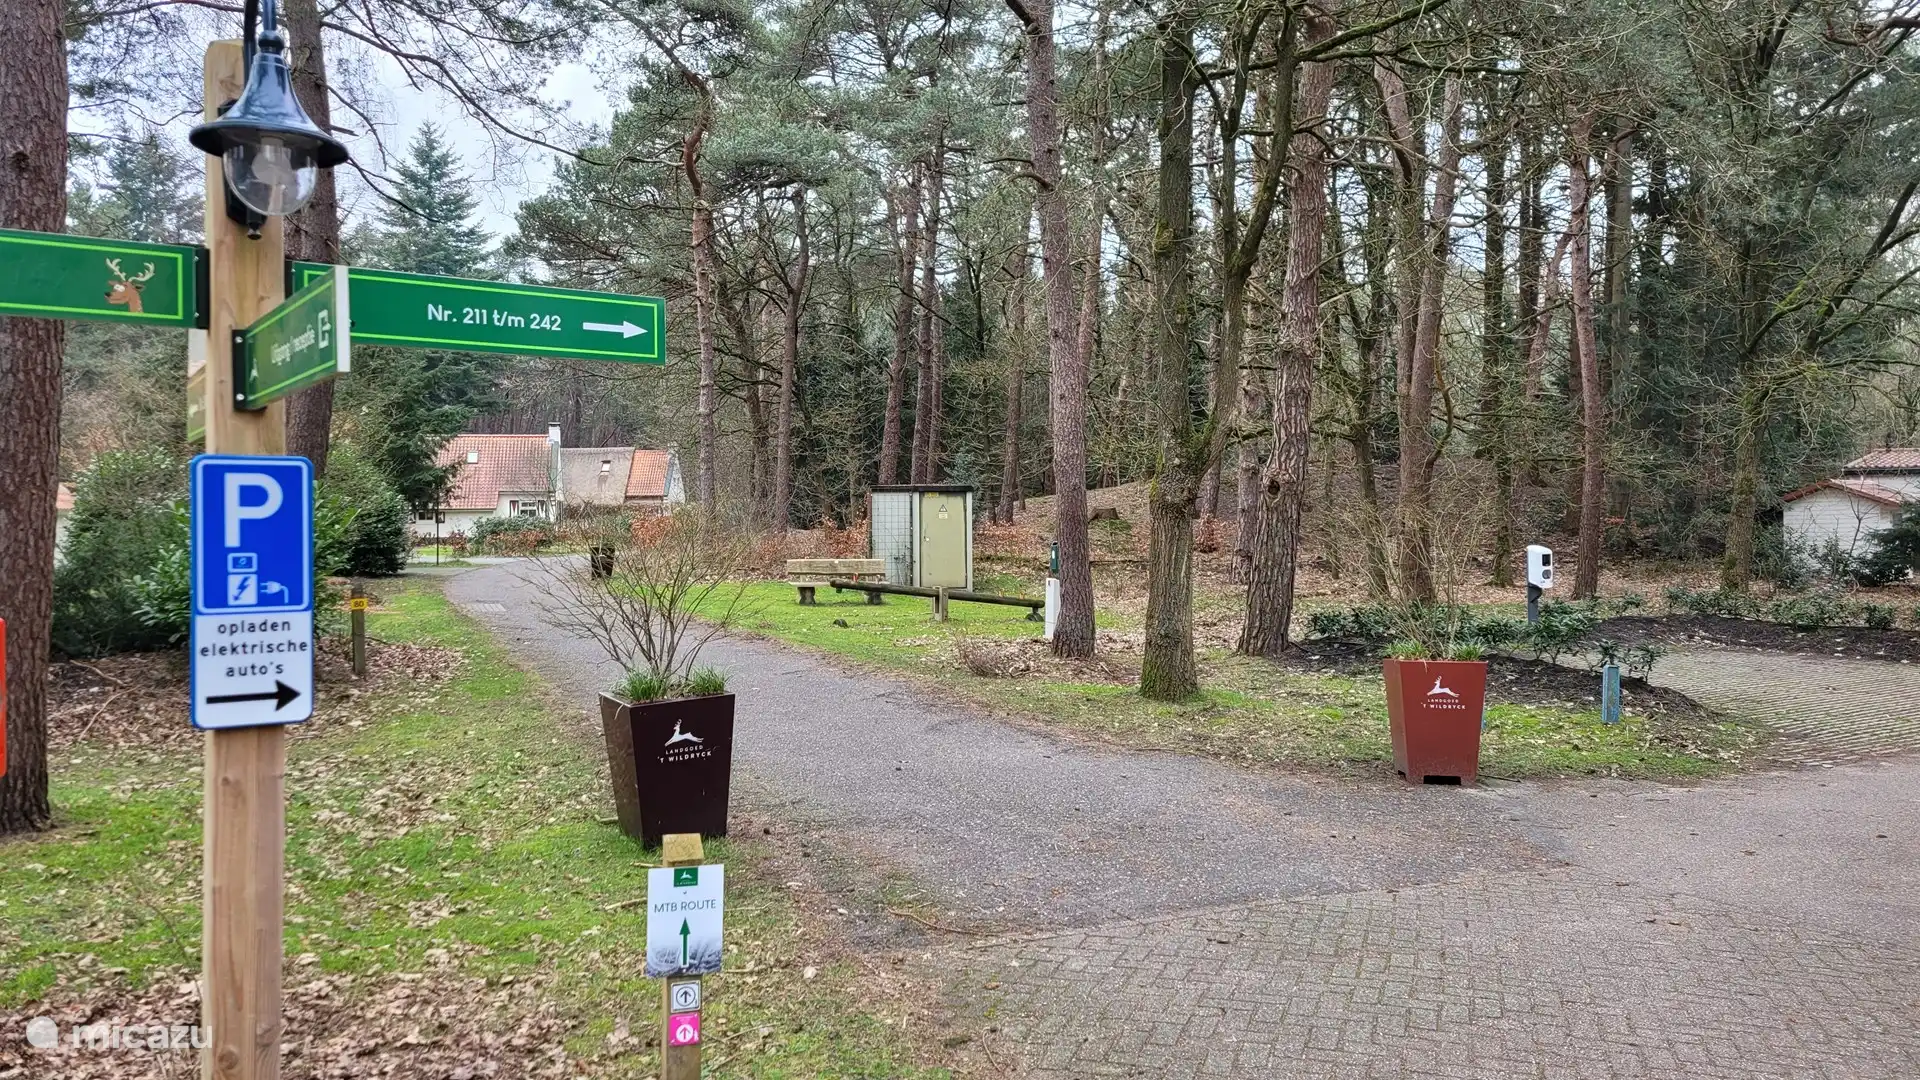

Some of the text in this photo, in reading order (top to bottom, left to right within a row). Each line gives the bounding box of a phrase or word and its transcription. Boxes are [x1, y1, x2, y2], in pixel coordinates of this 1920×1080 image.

[427, 303, 562, 331] Nr. 211 t/m 242
[224, 472, 284, 548] P
[217, 619, 291, 636] opladen
[200, 639, 308, 657] elektrische
[225, 661, 284, 677] auto's
[665, 744, 704, 755] LANDGOED
[668, 750, 712, 762] WILDRYCK
[654, 898, 717, 914] MTB ROUTE
